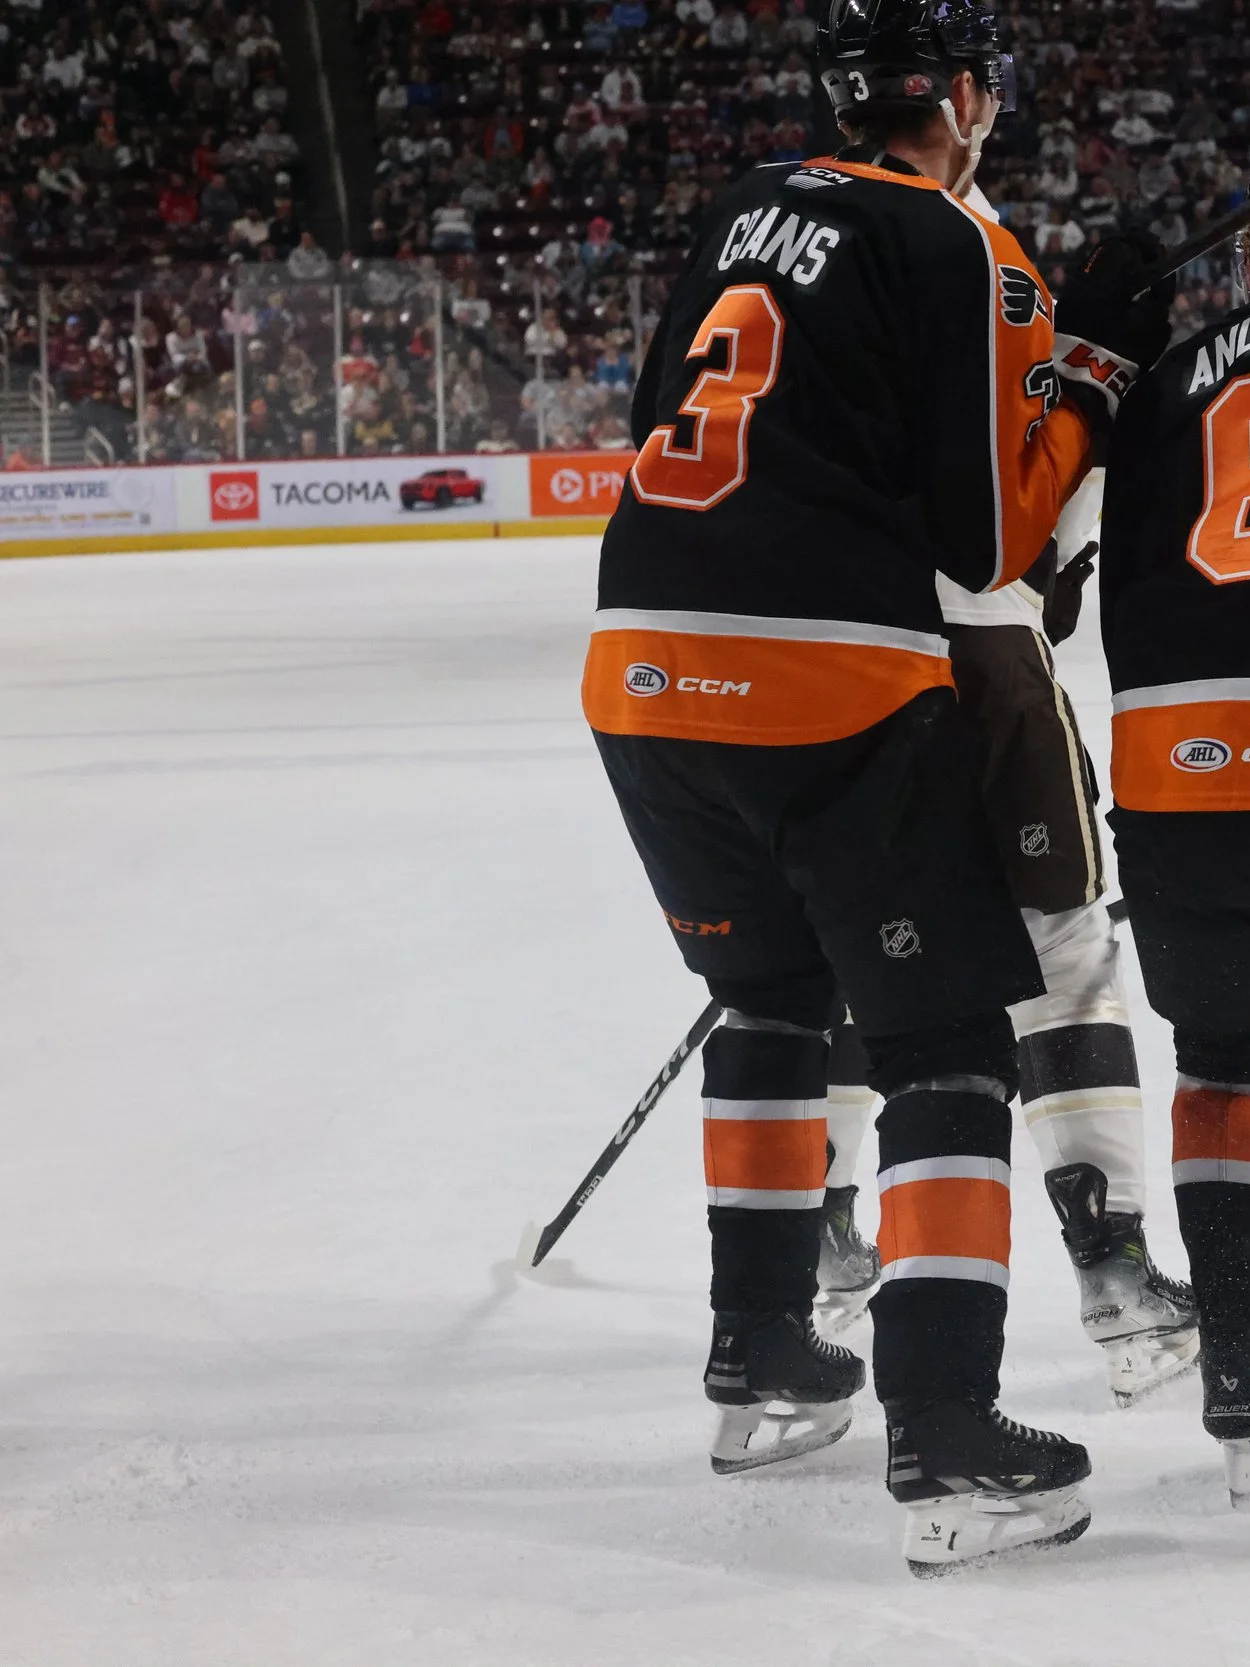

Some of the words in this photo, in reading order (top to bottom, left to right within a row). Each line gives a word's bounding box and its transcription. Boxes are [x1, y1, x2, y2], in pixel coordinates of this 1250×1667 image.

[849, 71, 869, 100] 3
[717, 206, 840, 286] GANS
[631, 284, 786, 511] 3
[271, 480, 390, 506] TACOMA
[629, 671, 656, 688] AHL
[677, 677, 752, 696] CCM
[1183, 747, 1217, 762] AHL
